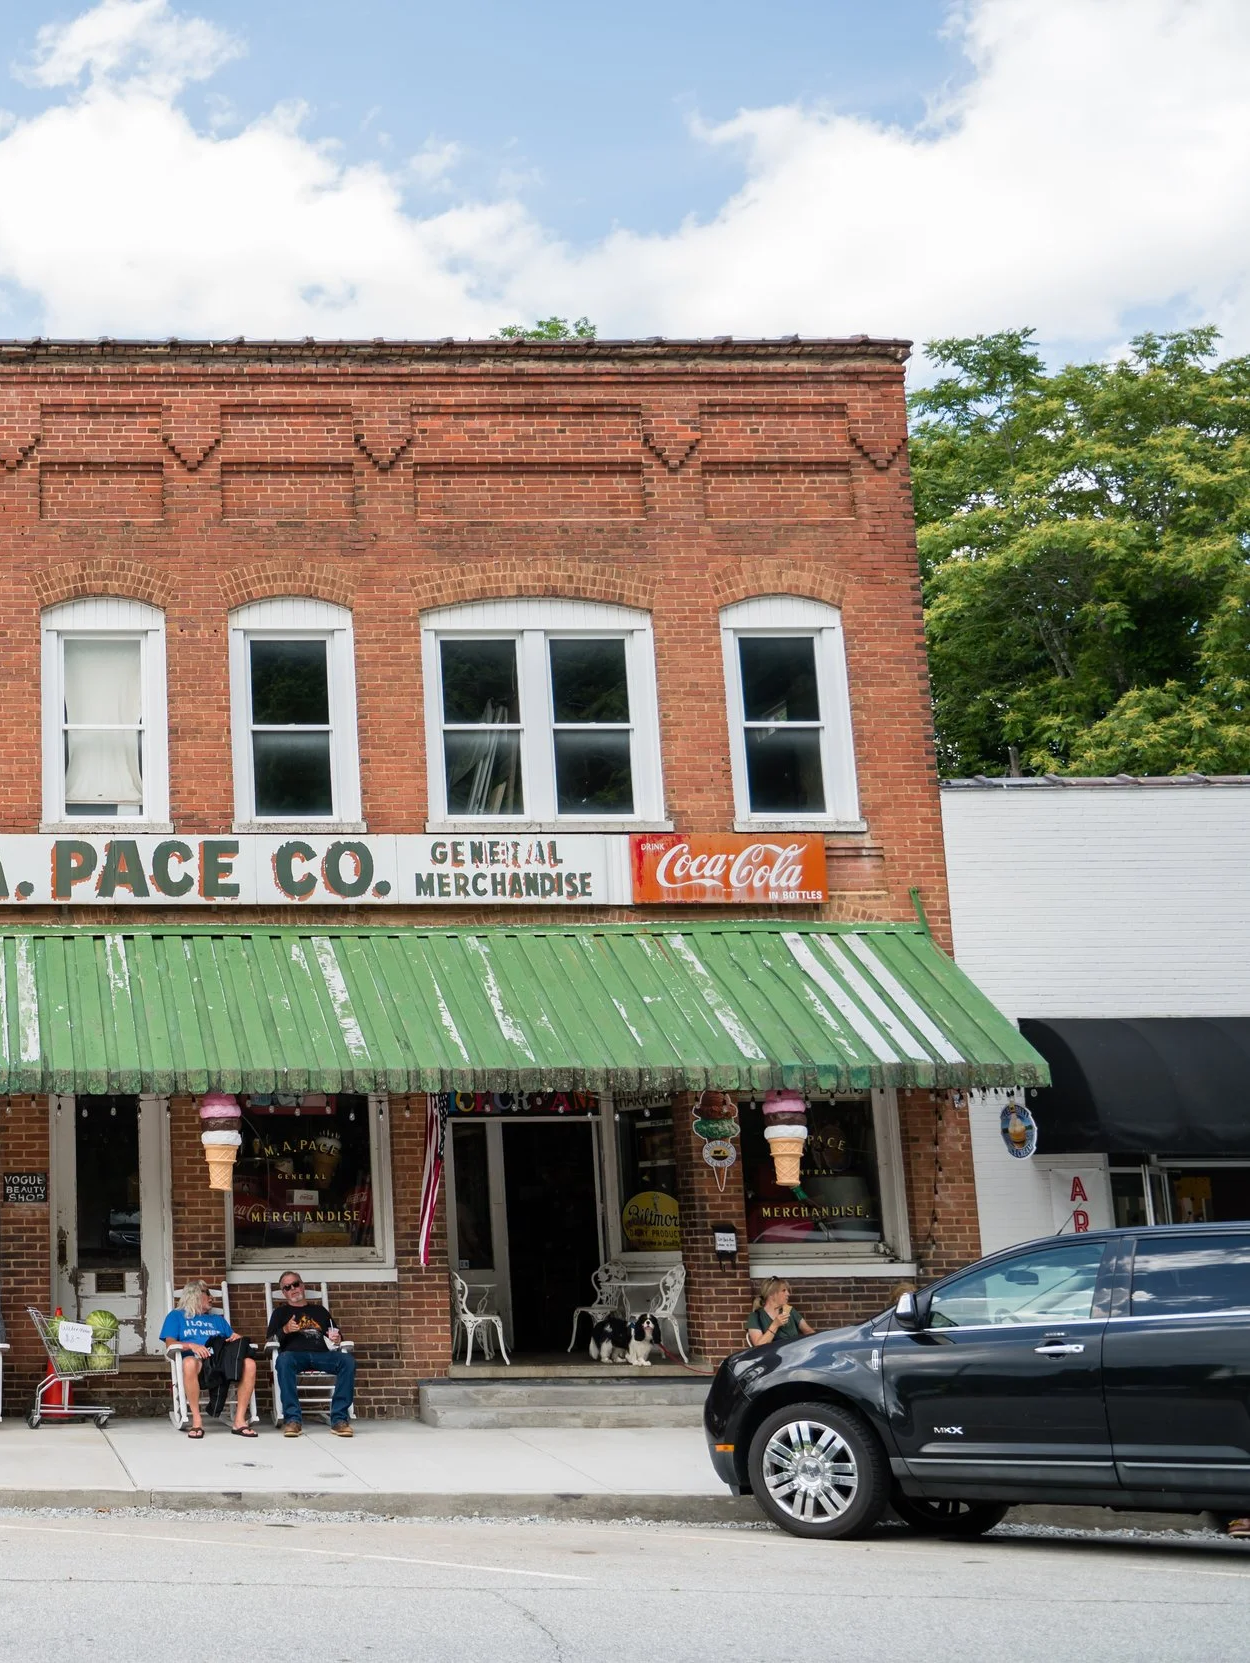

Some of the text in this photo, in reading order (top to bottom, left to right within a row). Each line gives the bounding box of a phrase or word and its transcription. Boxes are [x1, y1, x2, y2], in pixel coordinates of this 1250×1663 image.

[641, 843, 665, 851] DRINK
[50, 840, 240, 901] PACE
[271, 840, 392, 901] CO.
[656, 843, 808, 888] Coca-Cola
[415, 872, 593, 900] MERCHANDISE
[769, 891, 822, 900] IN BOTTLES
[300, 1139, 340, 1157] PACE
[4, 1175, 44, 1185] VOGUE
[6, 1186, 46, 1194] BEAUTY
[8, 1193, 45, 1202] SHOP
[251, 1210, 366, 1223] MERCHANDISE.
[628, 1204, 680, 1227] Biltmor
[762, 1205, 869, 1218] MERCHANDISE.
[190, 1320, 214, 1329] LOVE
[183, 1329, 198, 1337] MY
[933, 1426, 964, 1435] MKX
